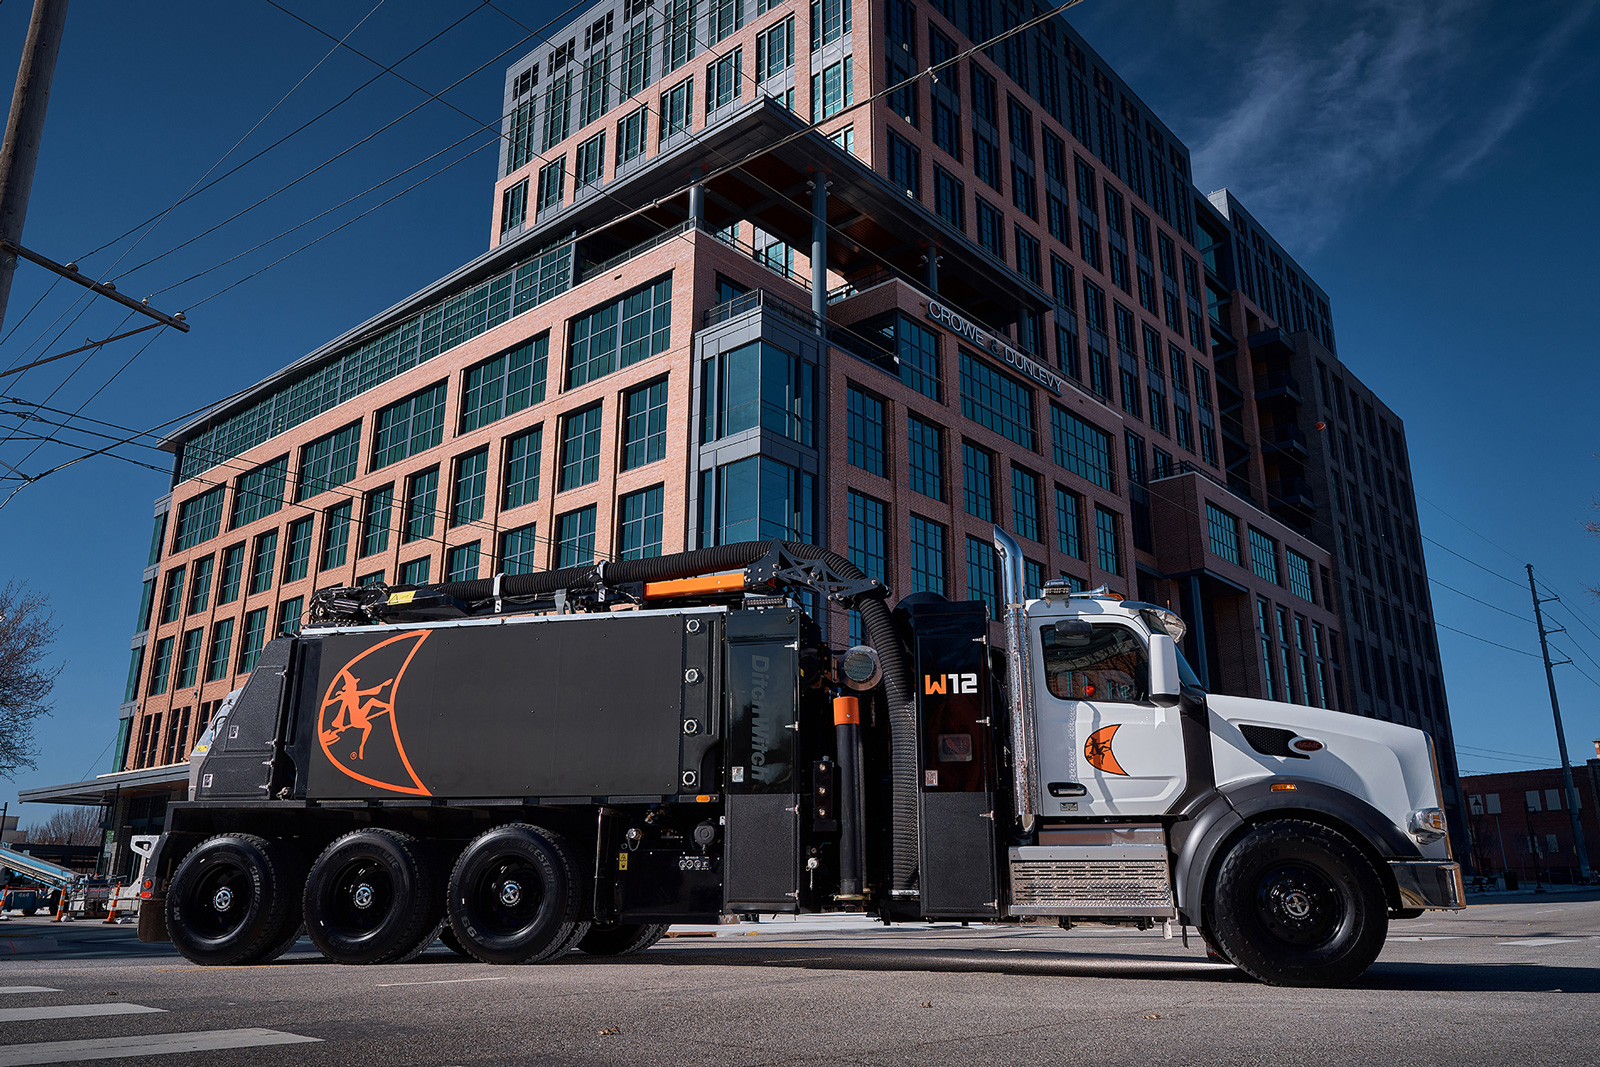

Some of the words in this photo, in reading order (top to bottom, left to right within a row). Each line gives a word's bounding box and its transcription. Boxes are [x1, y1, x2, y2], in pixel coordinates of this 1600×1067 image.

[929, 301, 984, 346] CROWE
[990, 339, 1001, 357] &
[1004, 346, 1062, 392] DUNLEVY
[752, 654, 770, 713] Ditch
[924, 673, 978, 695] W12
[752, 717, 770, 781] Witch
